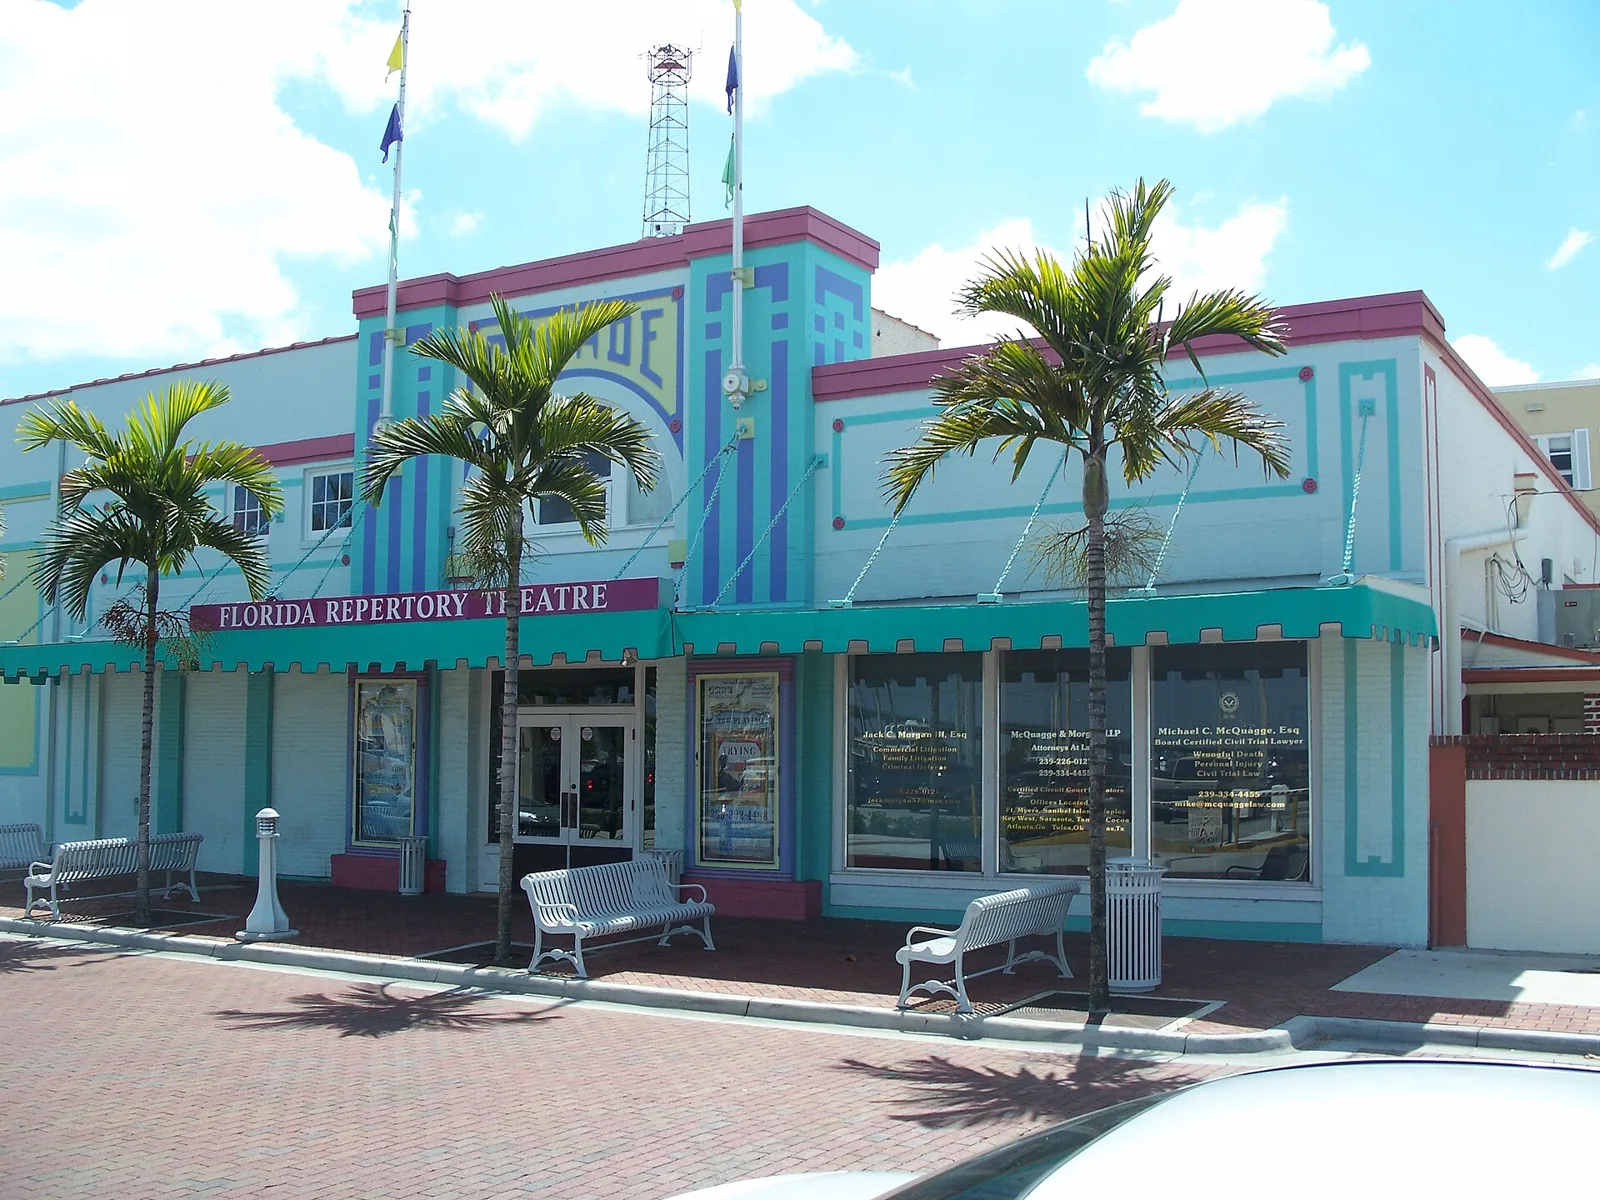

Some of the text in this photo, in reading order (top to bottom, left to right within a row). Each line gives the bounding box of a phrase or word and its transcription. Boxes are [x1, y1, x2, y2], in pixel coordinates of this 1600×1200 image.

[219, 602, 315, 628] FLORIDA
[325, 593, 468, 623] REPERTORY
[1011, 730, 1057, 740] McQuagge
[1059, 730, 1067, 738] &
[1068, 730, 1091, 739] Morg
[1158, 726, 1300, 736] Michael C. McQuagge, Esq
[898, 731, 932, 740] Morgan
[950, 731, 968, 740] Esq
[1183, 738, 1222, 746] Certified
[1270, 738, 1304, 746] Lawyer
[920, 746, 957, 754] Litigation
[1031, 744, 1069, 752] Attorneys
[1175, 801, 1286, 809] mike@mcquaggelaw.com
